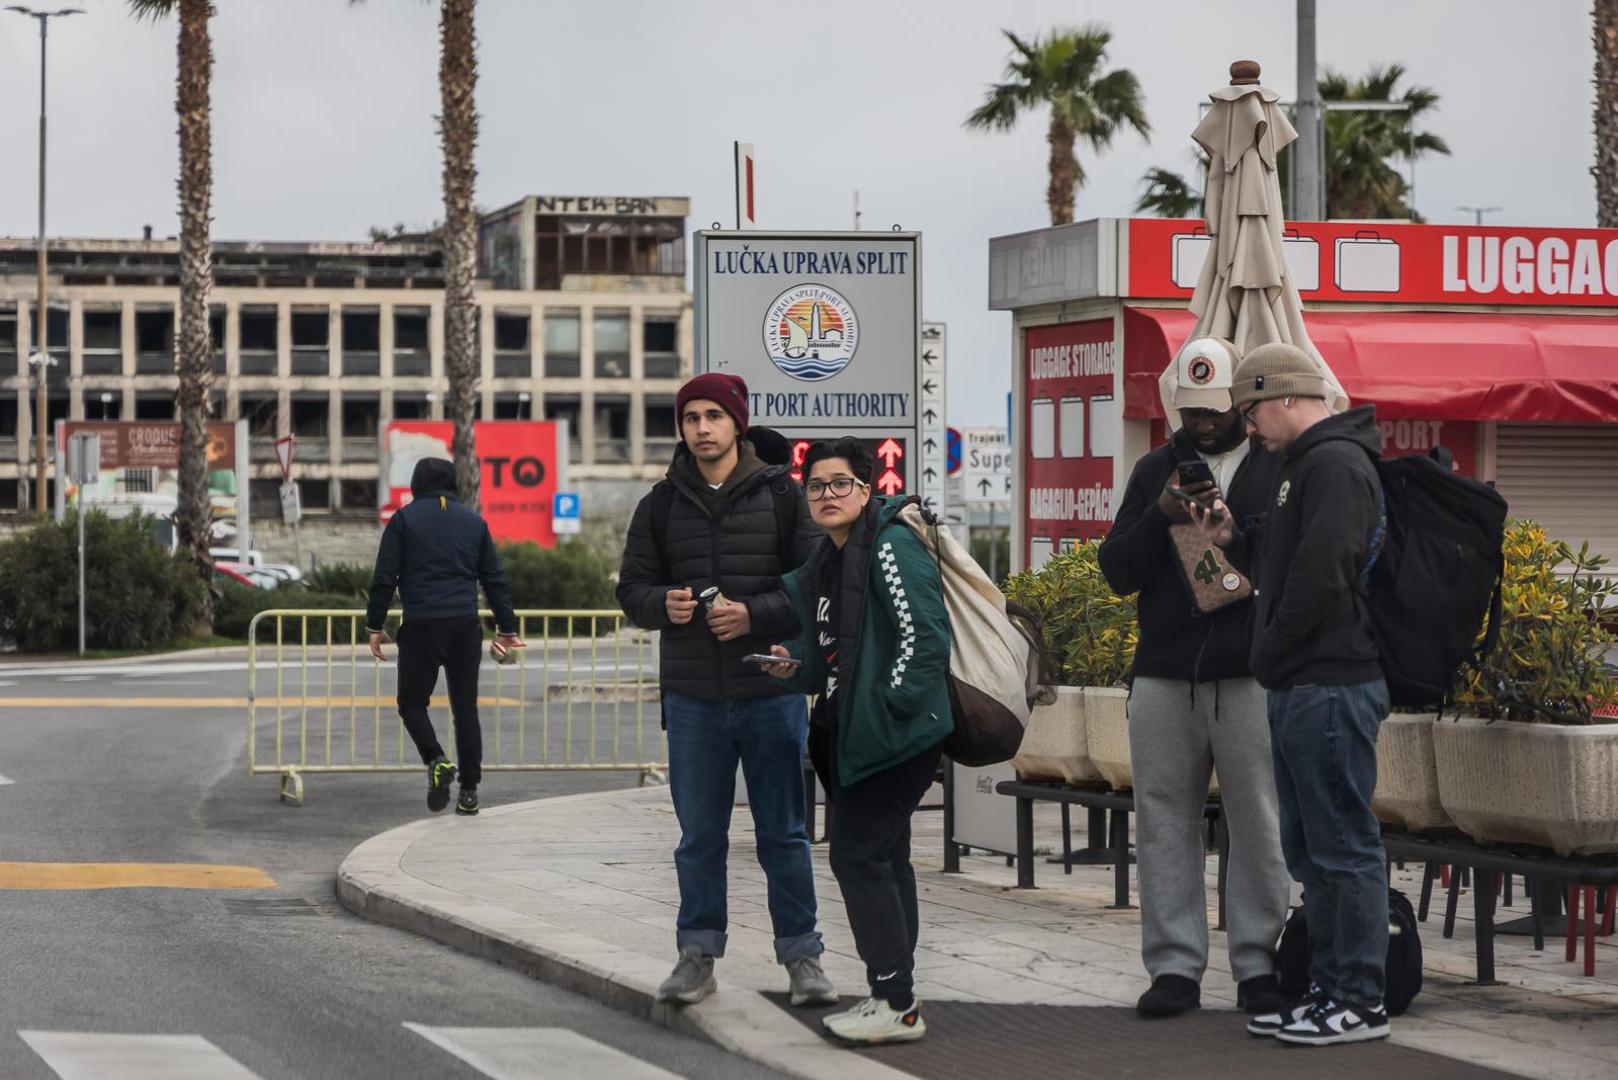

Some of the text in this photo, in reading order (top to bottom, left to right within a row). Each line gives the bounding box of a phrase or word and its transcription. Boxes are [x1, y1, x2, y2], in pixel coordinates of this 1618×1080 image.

[714, 245, 908, 274] LUČKA UPRAVA SPLIT
[1031, 345, 1072, 380] LUGGAGE
[766, 393, 809, 417] PORT
[812, 393, 909, 417] AUTHORITY
